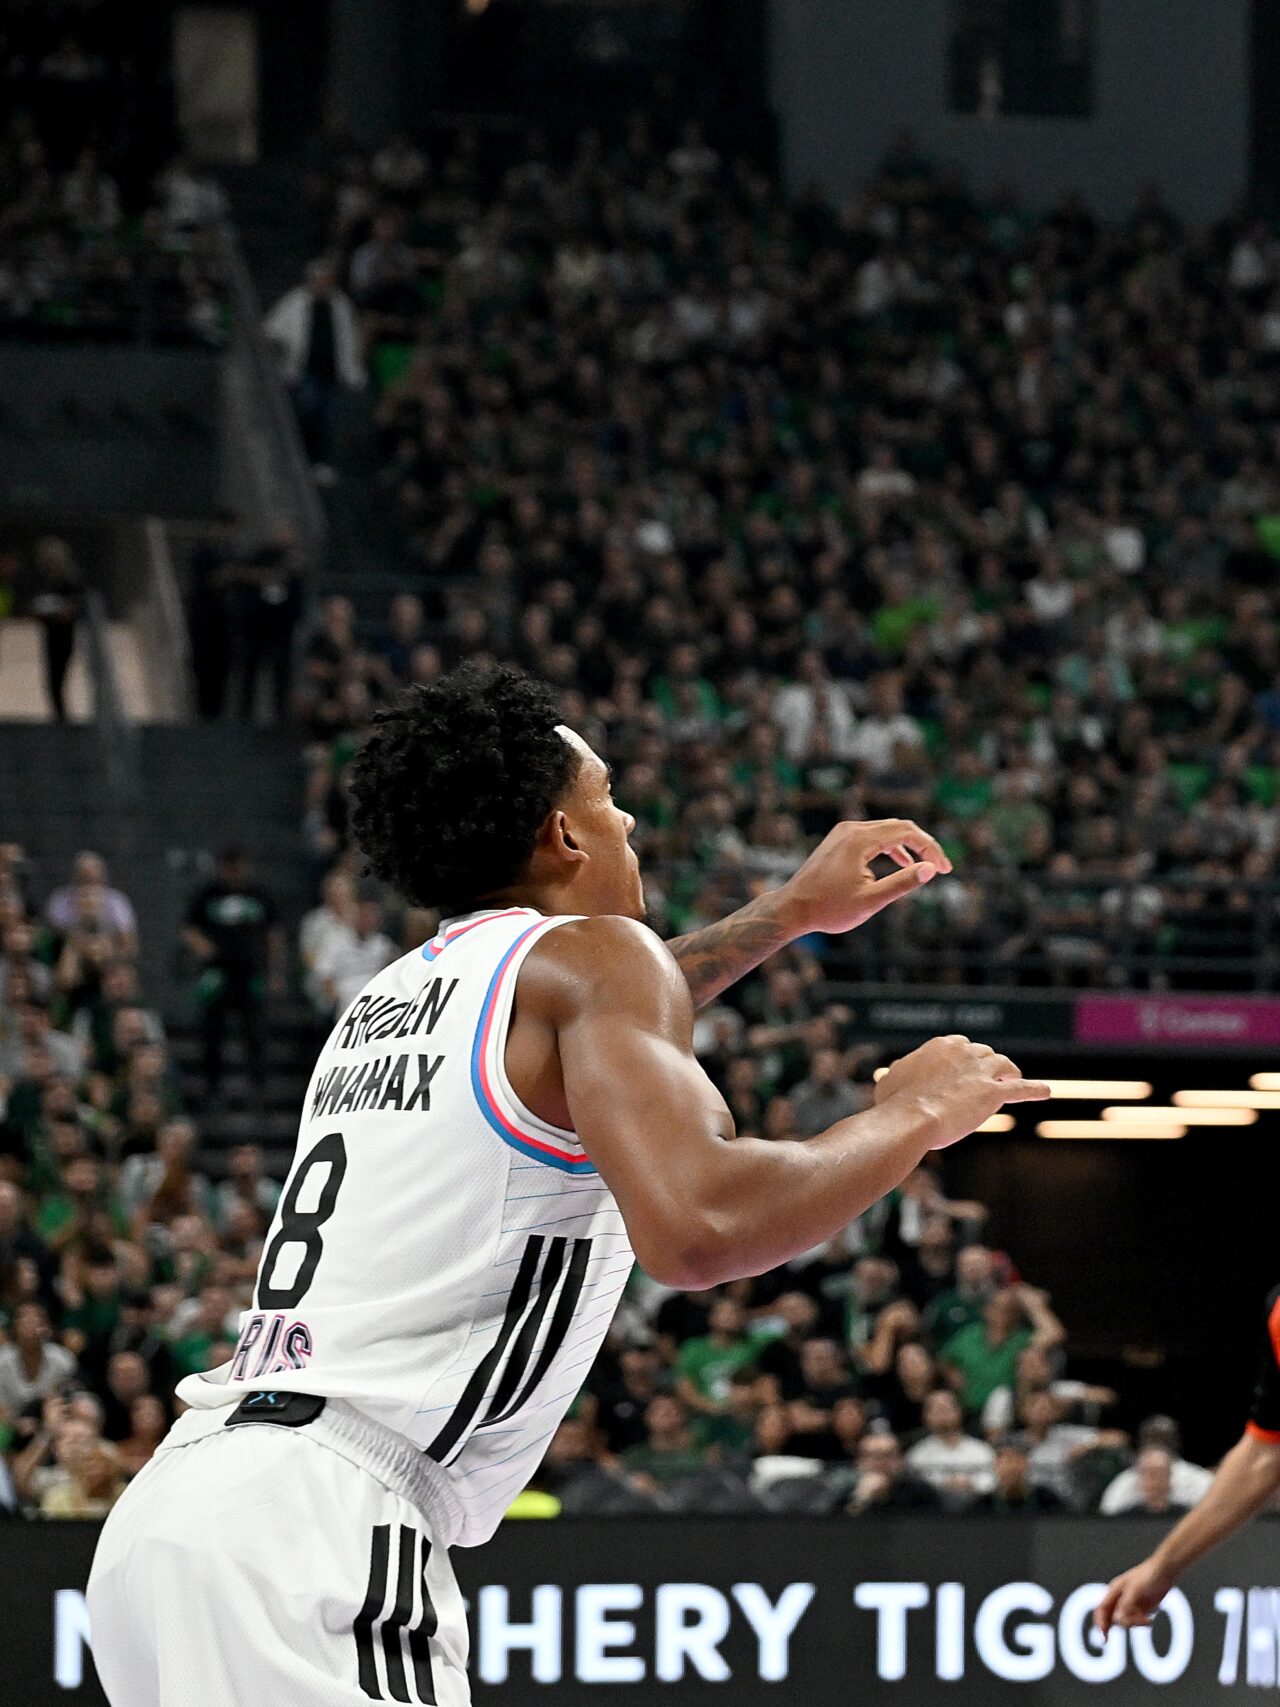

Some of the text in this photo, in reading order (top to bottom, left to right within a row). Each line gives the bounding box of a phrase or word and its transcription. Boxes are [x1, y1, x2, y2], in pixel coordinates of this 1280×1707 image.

[258, 1132, 347, 1310] 8
[464, 1582, 816, 1684] HERY
[853, 1582, 1194, 1684] TIGGO
